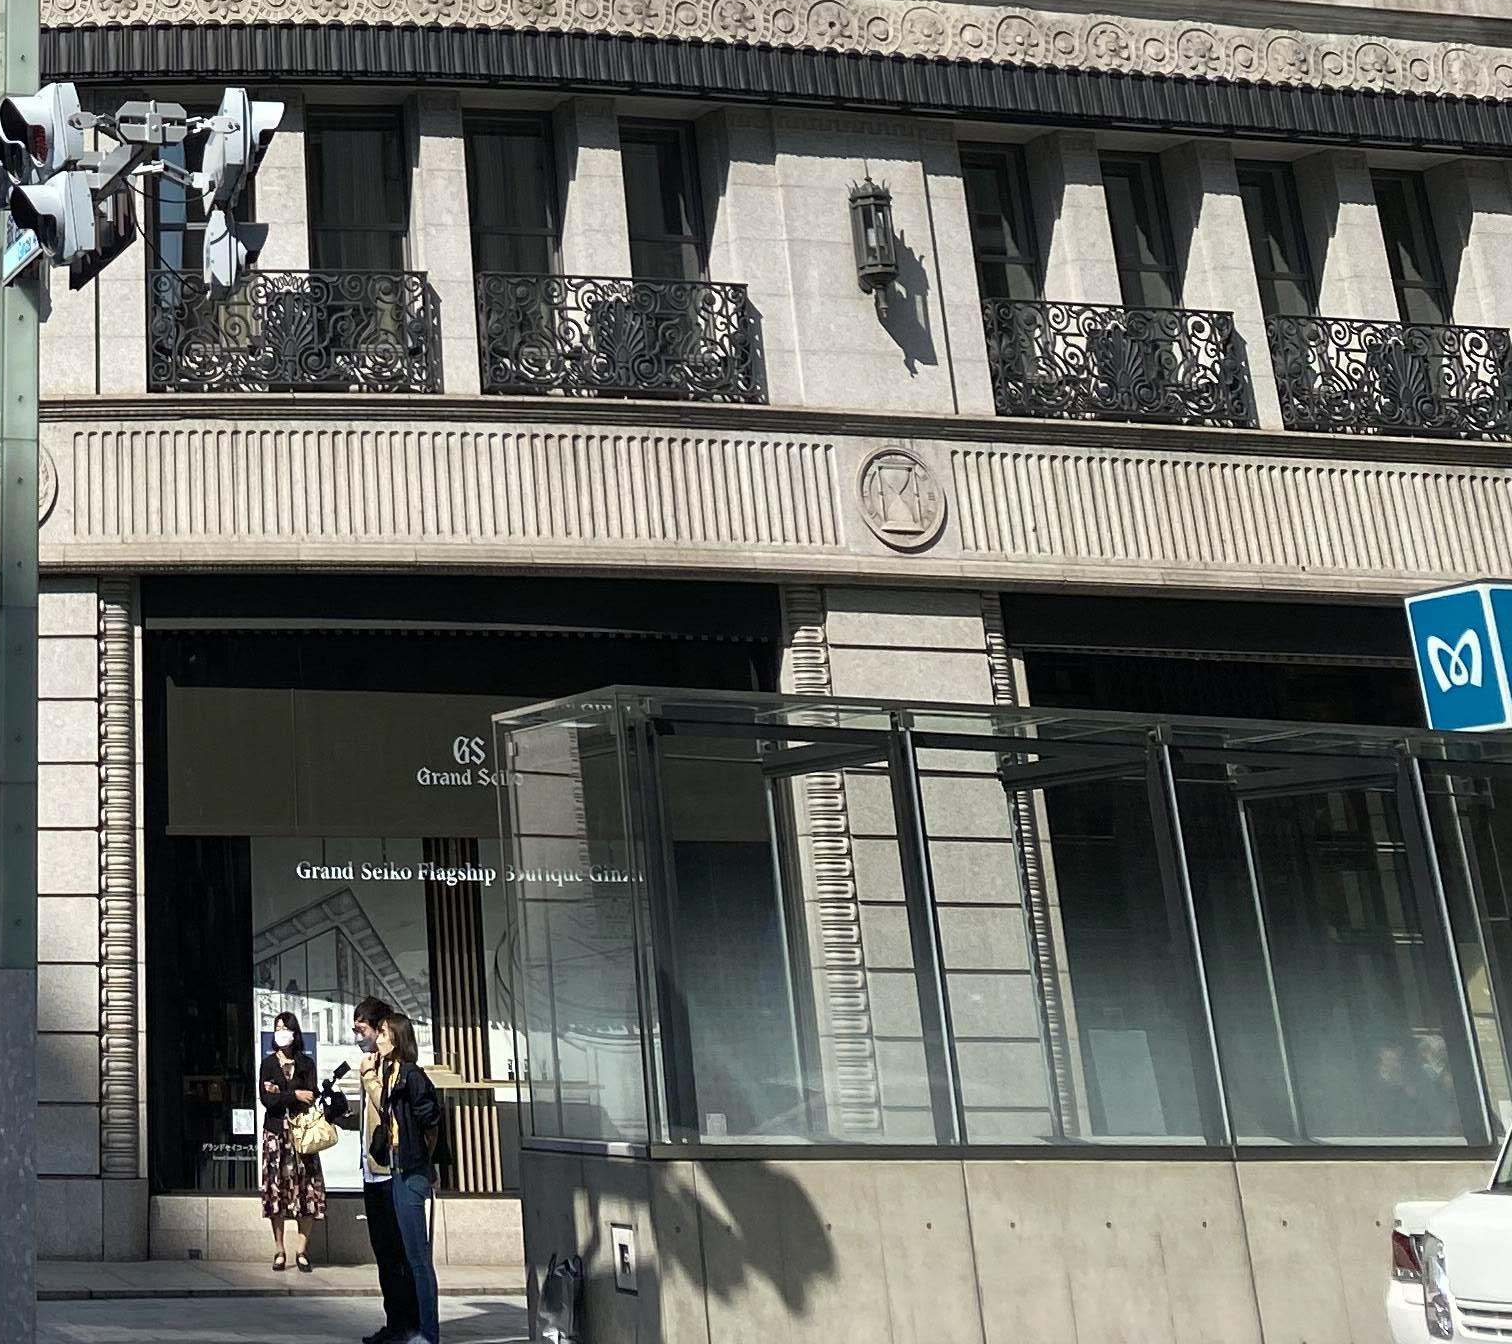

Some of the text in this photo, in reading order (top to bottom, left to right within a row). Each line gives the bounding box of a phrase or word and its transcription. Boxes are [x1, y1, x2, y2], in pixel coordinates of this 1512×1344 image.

[452, 735, 487, 765] GS
[416, 766, 524, 787] Grand Seio
[295, 860, 354, 880] Grand
[360, 861, 413, 881] Seiko
[417, 862, 497, 887] Flagship
